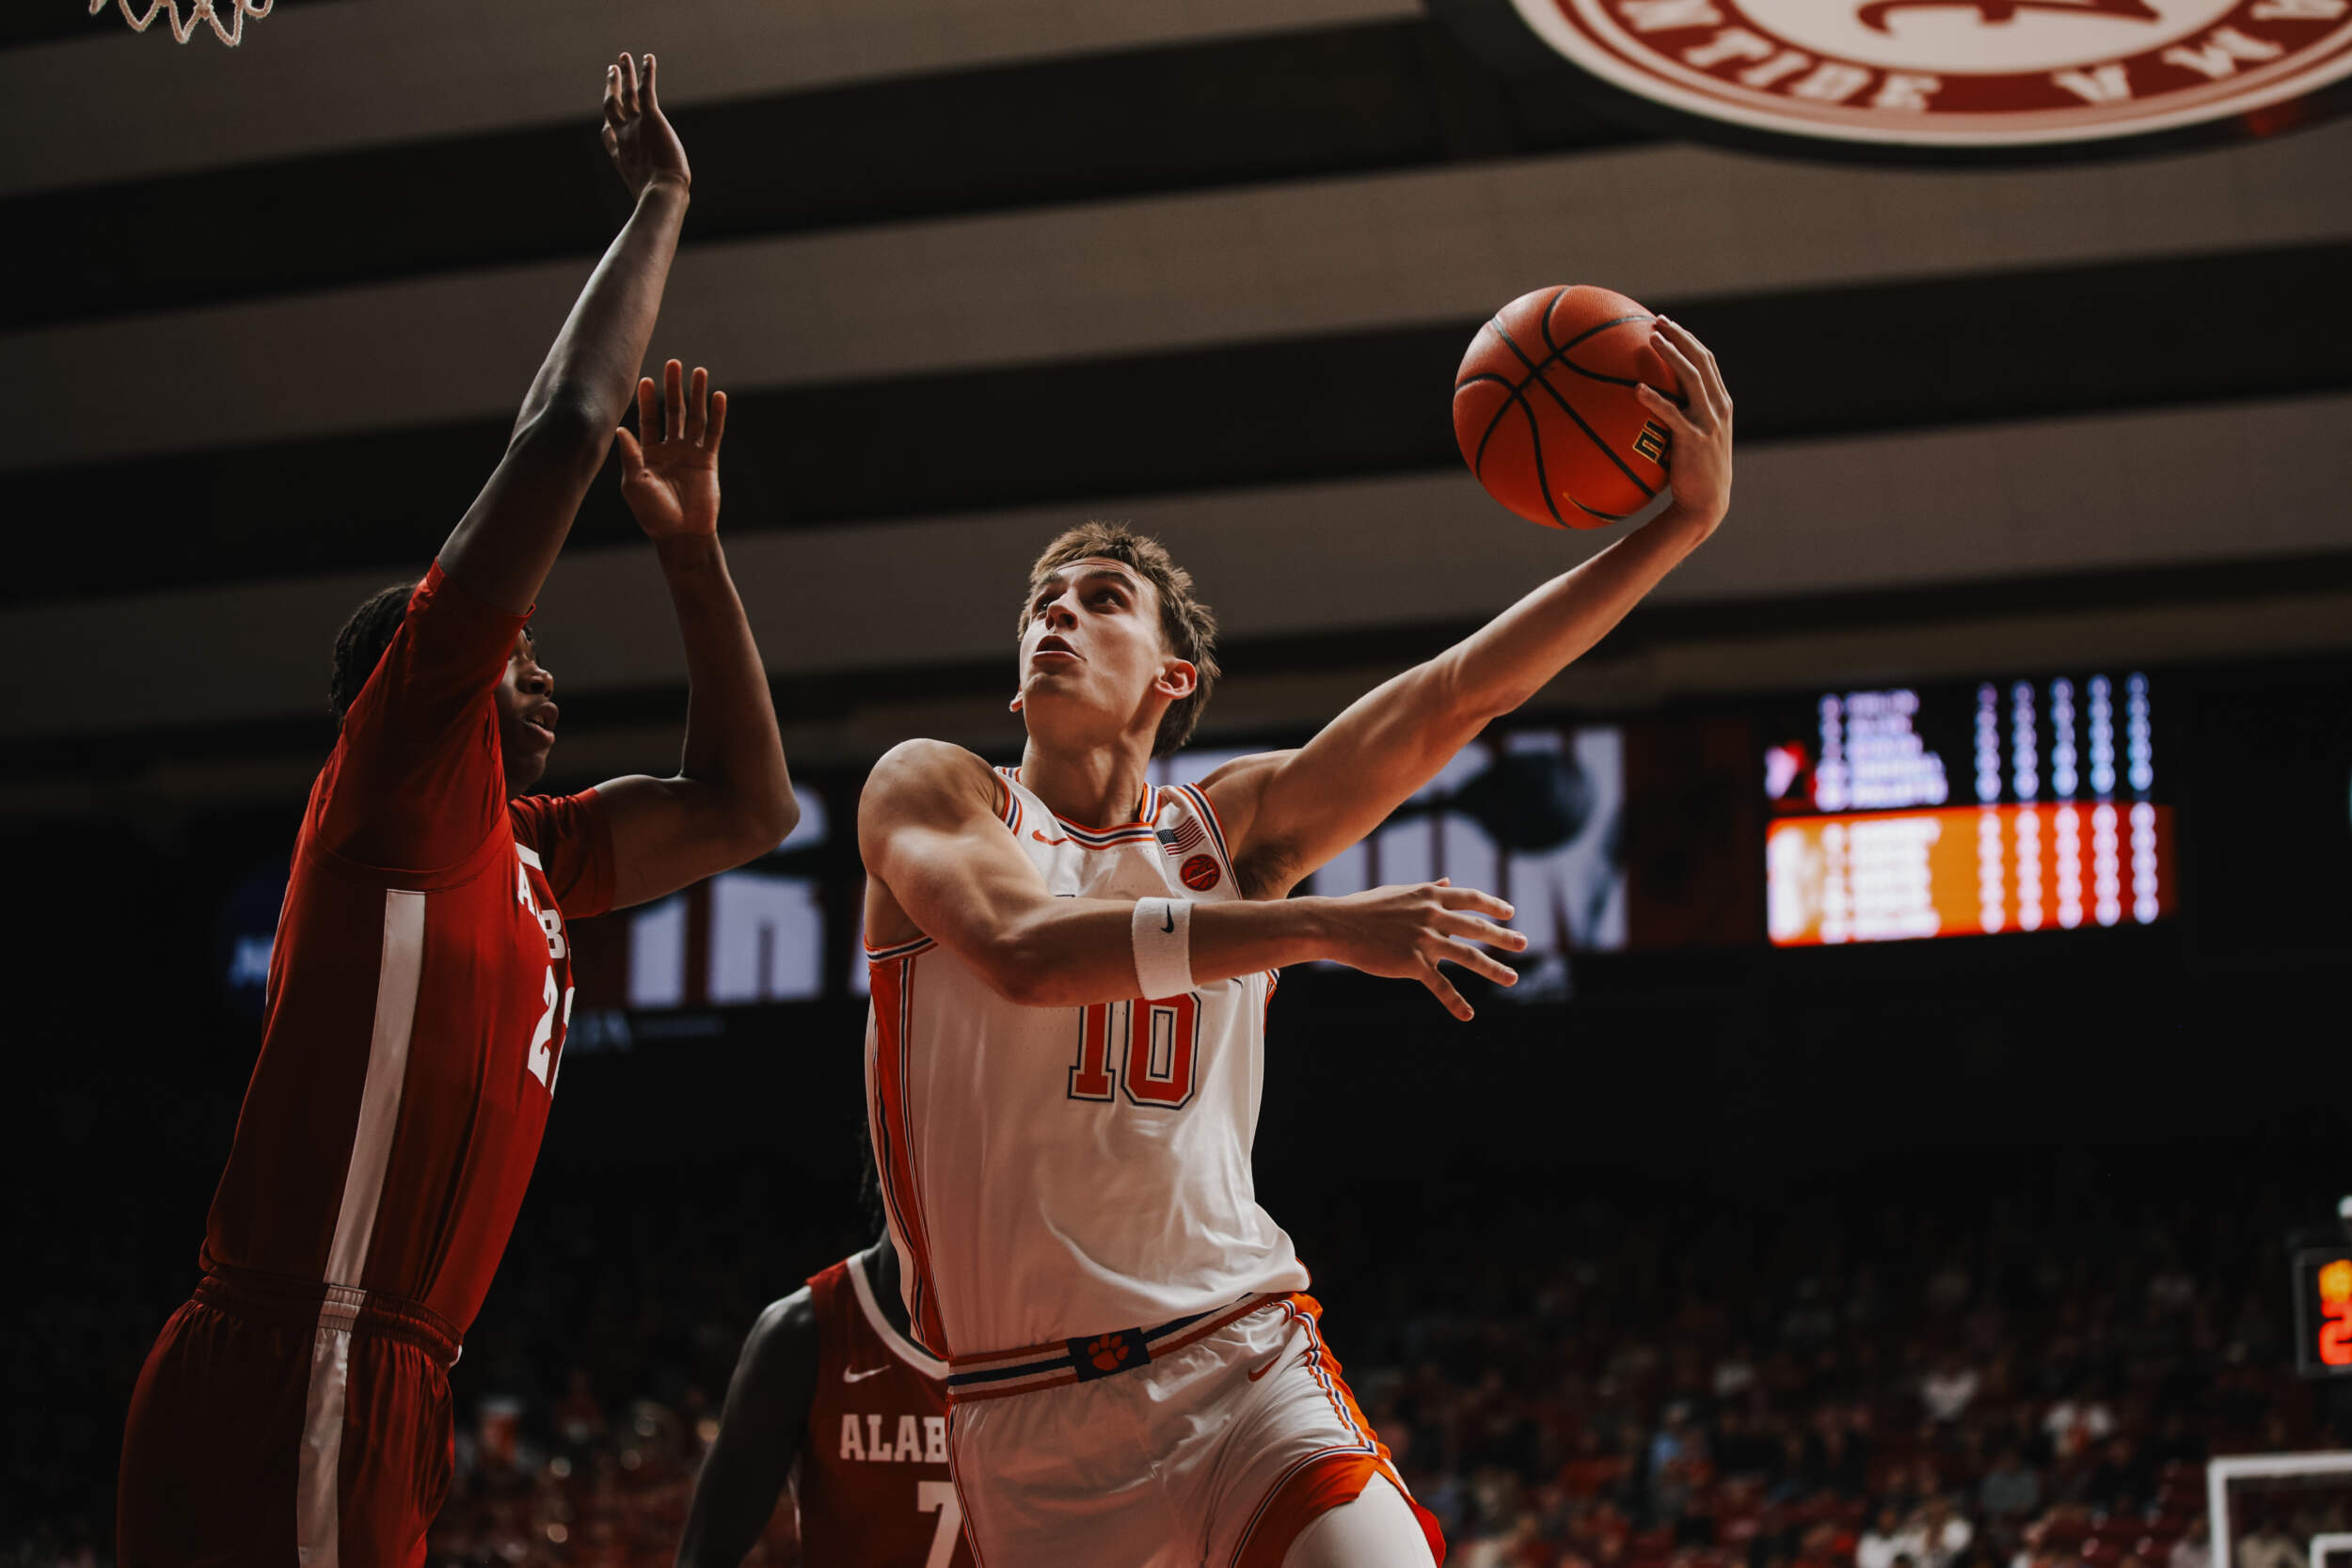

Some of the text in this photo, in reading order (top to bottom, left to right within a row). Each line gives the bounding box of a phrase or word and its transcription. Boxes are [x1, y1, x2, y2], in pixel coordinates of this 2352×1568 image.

[1682, 25, 1943, 111] TIDE
[1067, 992, 1202, 1111] 10
[917, 1481, 963, 1568] 7
